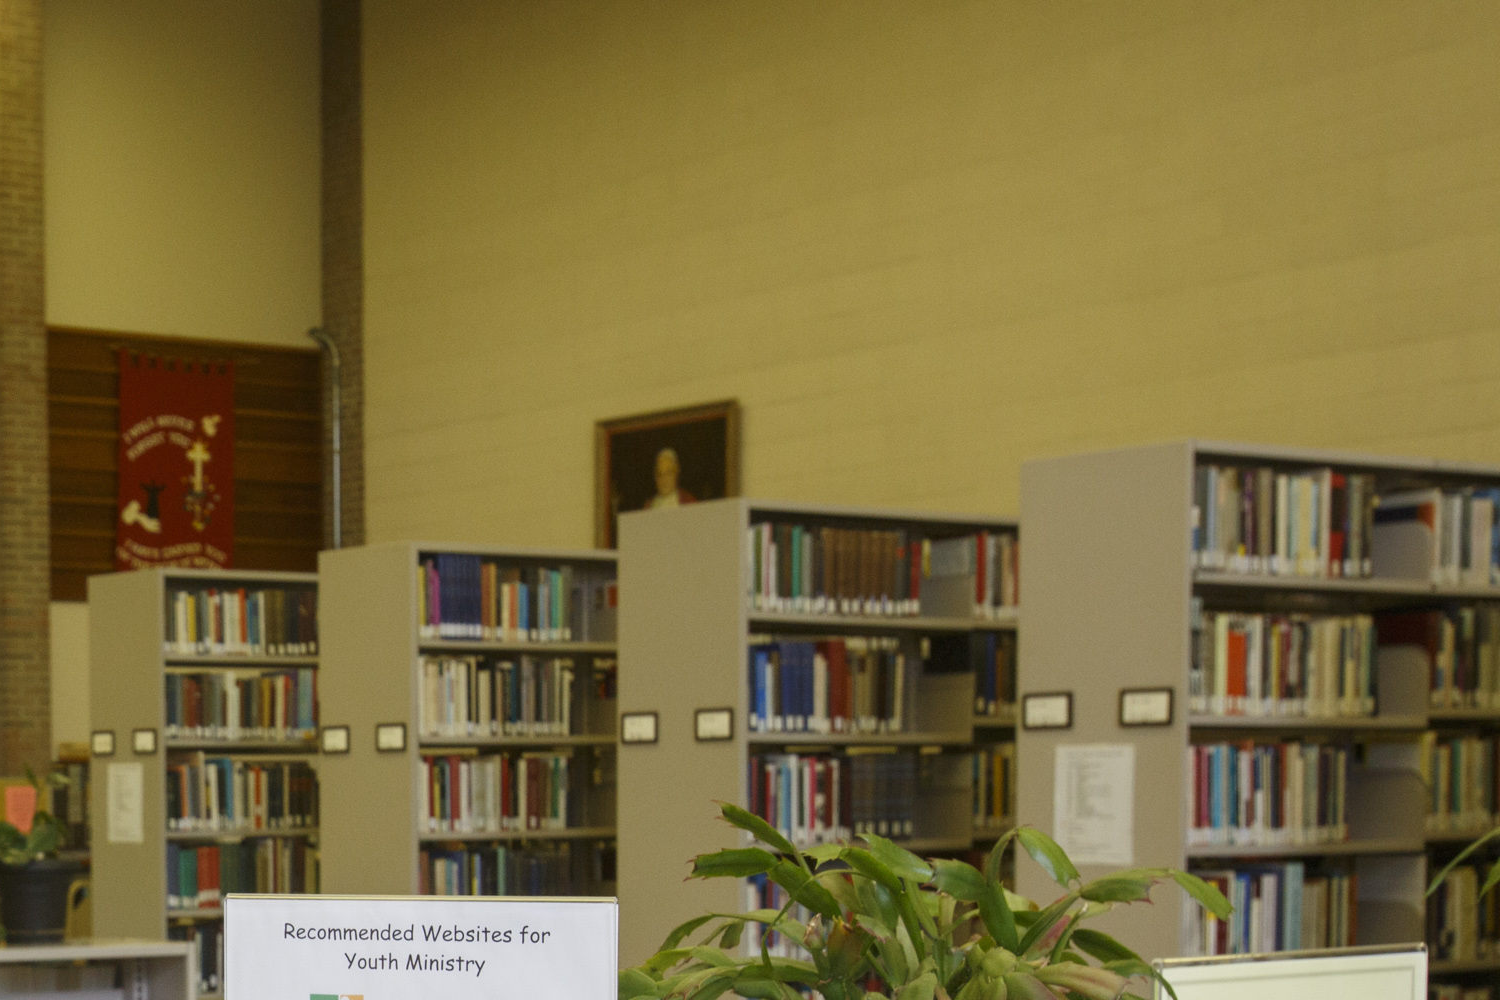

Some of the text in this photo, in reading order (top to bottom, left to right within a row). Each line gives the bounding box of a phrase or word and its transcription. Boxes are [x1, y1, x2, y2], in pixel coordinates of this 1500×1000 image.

[284, 923, 550, 944] Recommended Websites for
[345, 952, 485, 977] Youth Ministry
